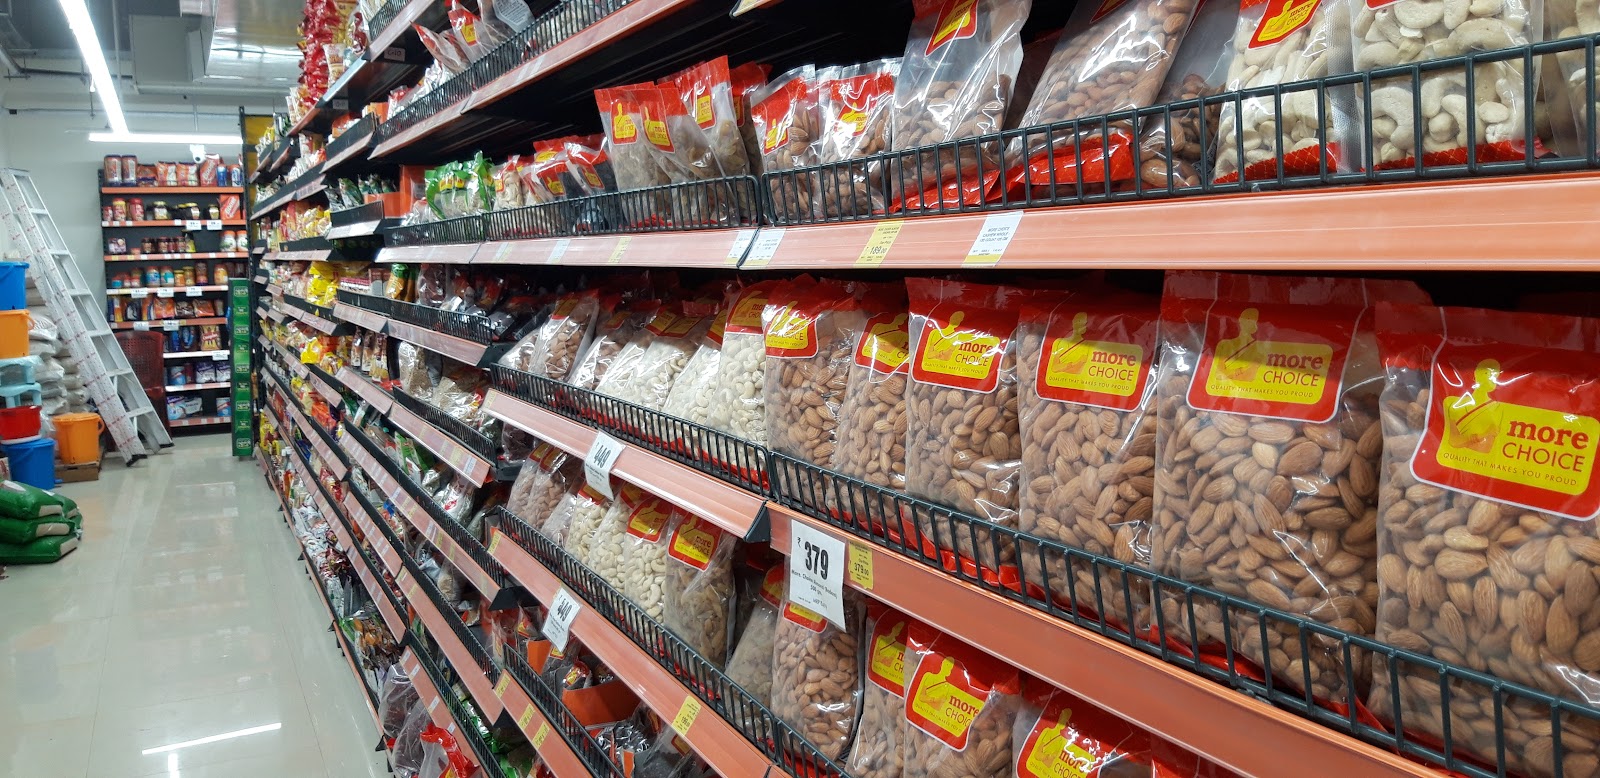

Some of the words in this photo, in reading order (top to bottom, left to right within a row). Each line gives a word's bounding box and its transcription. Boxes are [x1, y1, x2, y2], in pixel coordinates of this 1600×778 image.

[955, 353, 989, 367] CHOICE
[1091, 350, 1137, 367] more
[1266, 353, 1323, 370] more
[1088, 365, 1134, 381] CHOICE
[1263, 370, 1320, 387] CHOICE
[1506, 420, 1589, 450] more
[1502, 441, 1586, 473] CHOICE
[1443, 452, 1471, 463] QUALITY
[1472, 458, 1488, 467] THAT
[1490, 463, 1518, 474] MAKES
[1521, 469, 1541, 479] YOU
[1545, 474, 1577, 486] PROUD
[804, 541, 829, 580] 379
[949, 695, 980, 718] more
[945, 707, 971, 727] CHOIC
